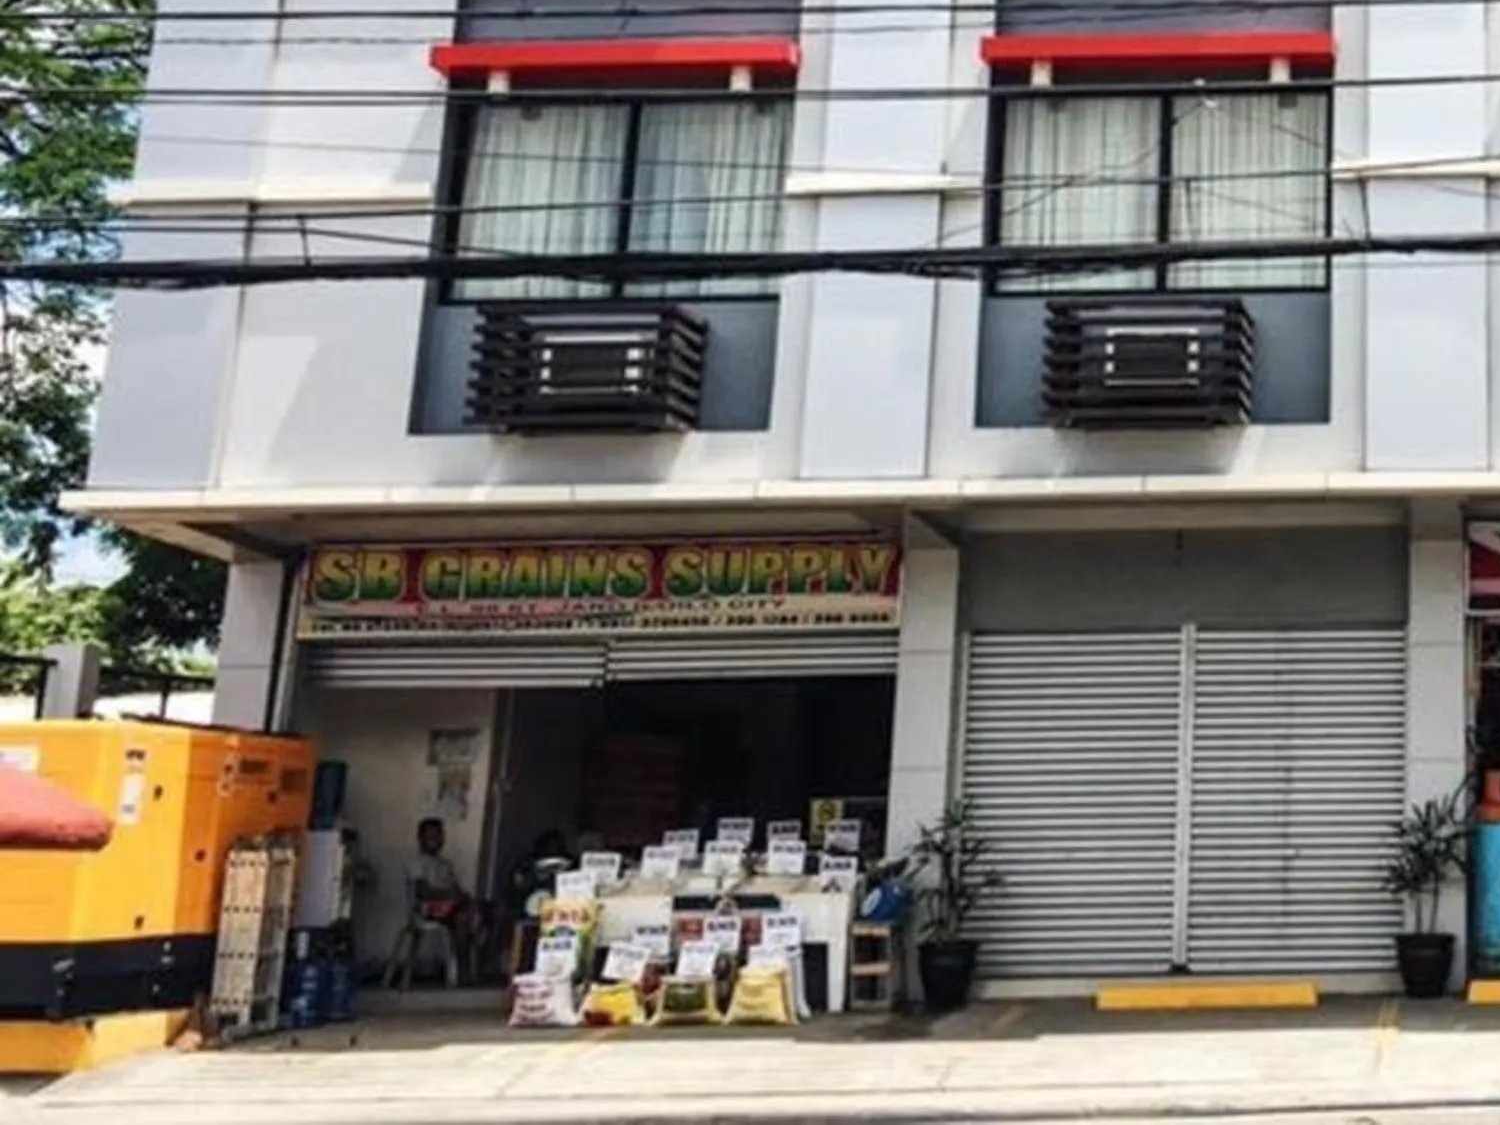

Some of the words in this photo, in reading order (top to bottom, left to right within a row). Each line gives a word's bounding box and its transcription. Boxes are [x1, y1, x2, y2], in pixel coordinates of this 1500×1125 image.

[313, 547, 403, 603] SB
[420, 546, 651, 602] GRAINS
[662, 543, 895, 599] SUPPLY
